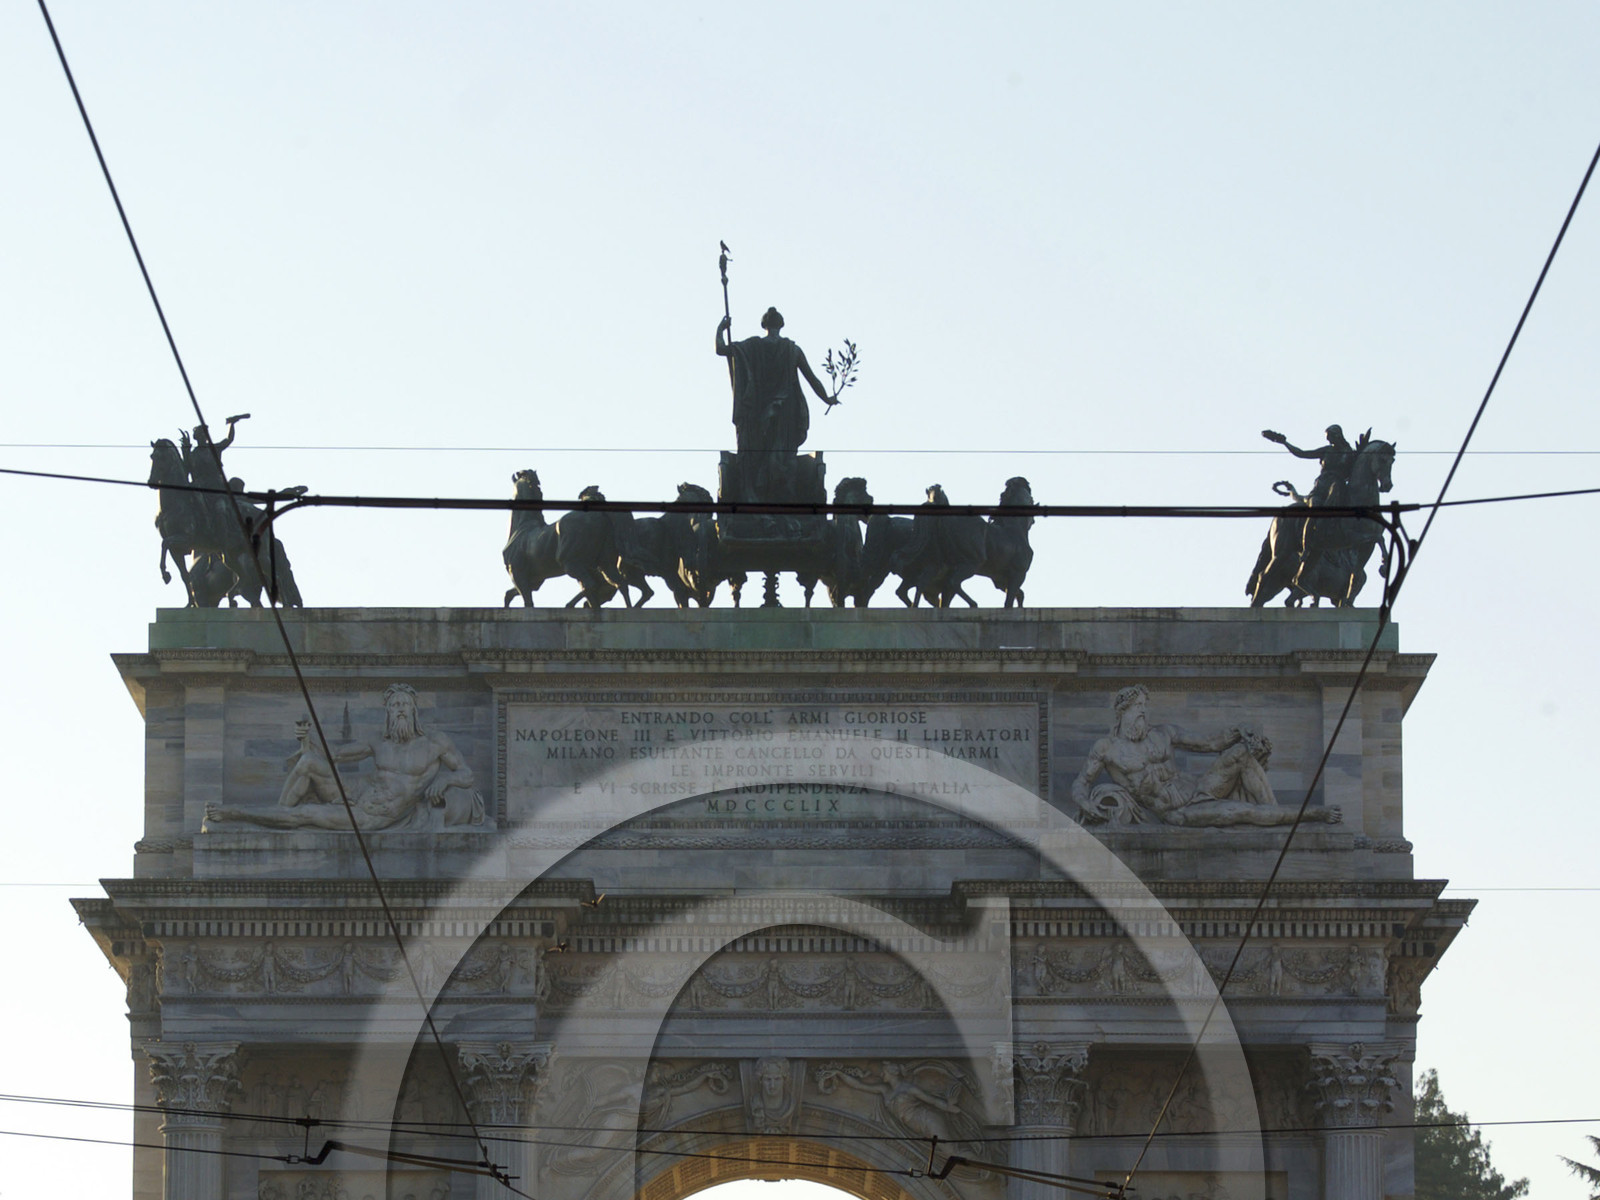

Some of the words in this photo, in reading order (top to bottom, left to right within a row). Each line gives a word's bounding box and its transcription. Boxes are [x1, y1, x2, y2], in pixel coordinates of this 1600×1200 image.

[620, 711, 714, 724] ENTRANDO
[787, 711, 829, 724] ARMI
[844, 711, 927, 724] GLORIOSE
[515, 729, 619, 742] NAPOLEONE
[633, 729, 650, 742] III
[666, 729, 675, 742] E
[690, 729, 774, 742] VITTORIO
[787, 729, 882, 742] EMANUELE
[896, 729, 908, 742] II
[923, 729, 1030, 742] LIBERATORI
[546, 747, 615, 760] MILANO
[629, 747, 723, 760] ESULTANTE
[734, 747, 823, 760] CANCELLO
[836, 747, 856, 760] DA
[870, 746, 931, 760] QUESTI
[943, 747, 999, 760] MARMI
[672, 765, 689, 777] LE
[704, 764, 793, 777] IMPRONTE
[807, 764, 875, 777] SERVILI
[573, 782, 582, 795] E
[599, 782, 616, 795] VI
[630, 782, 697, 795] SCRISSE
[734, 782, 869, 795] INDIPENDENZA
[912, 782, 971, 795] ITALIA
